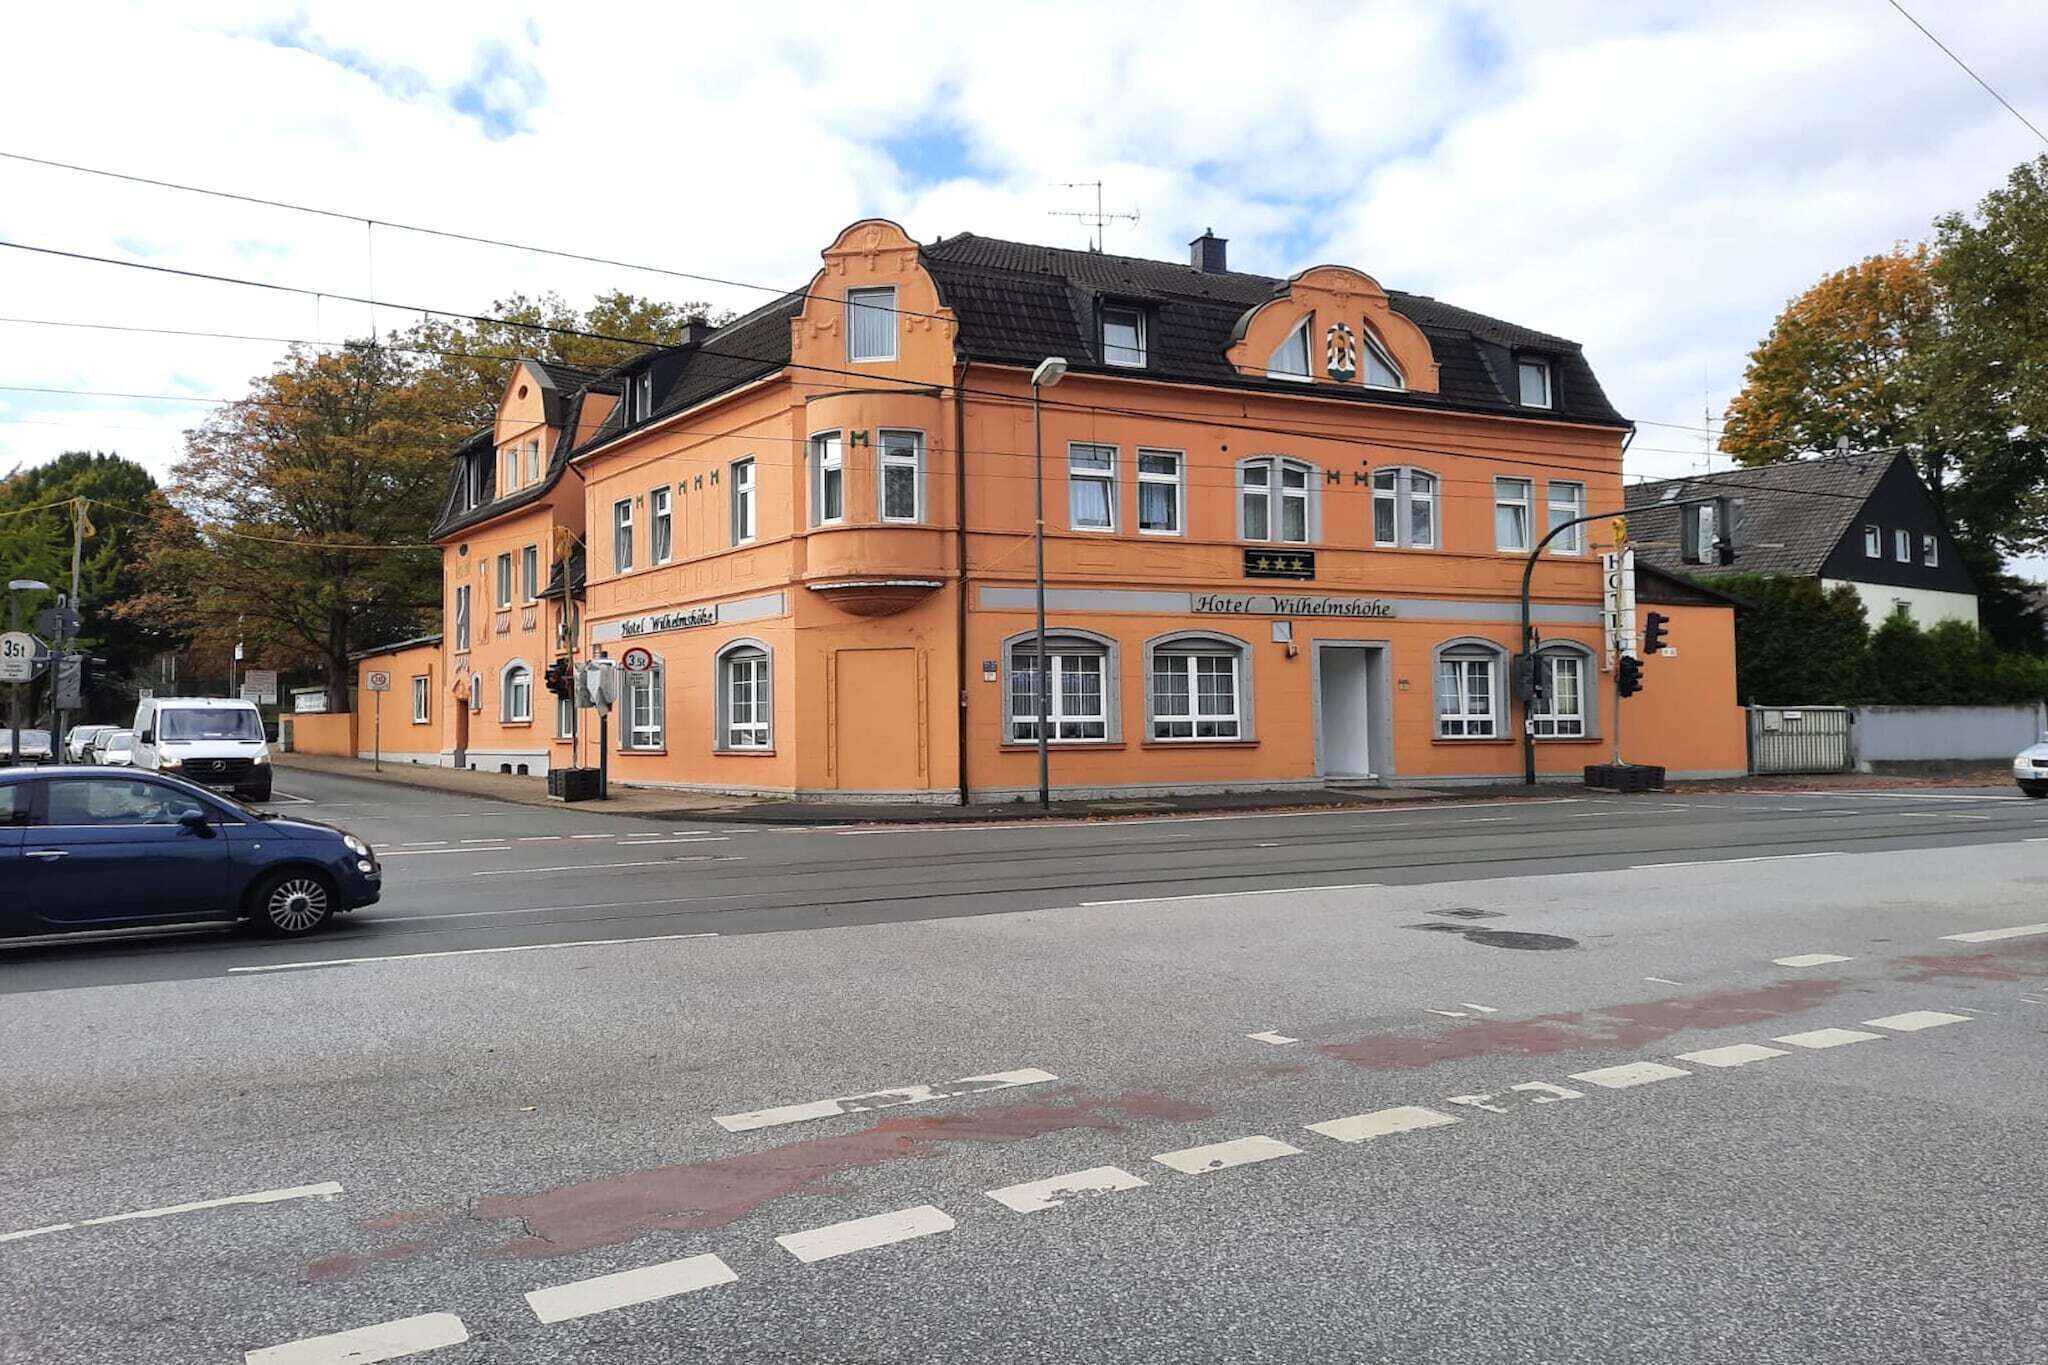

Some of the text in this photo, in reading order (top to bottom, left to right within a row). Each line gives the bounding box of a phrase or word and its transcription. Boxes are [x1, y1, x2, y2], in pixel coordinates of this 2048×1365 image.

[1196, 594, 1391, 616] Hotel Wilhelmshöhe
[621, 607, 713, 635] Hotel Wilhelmshöhe
